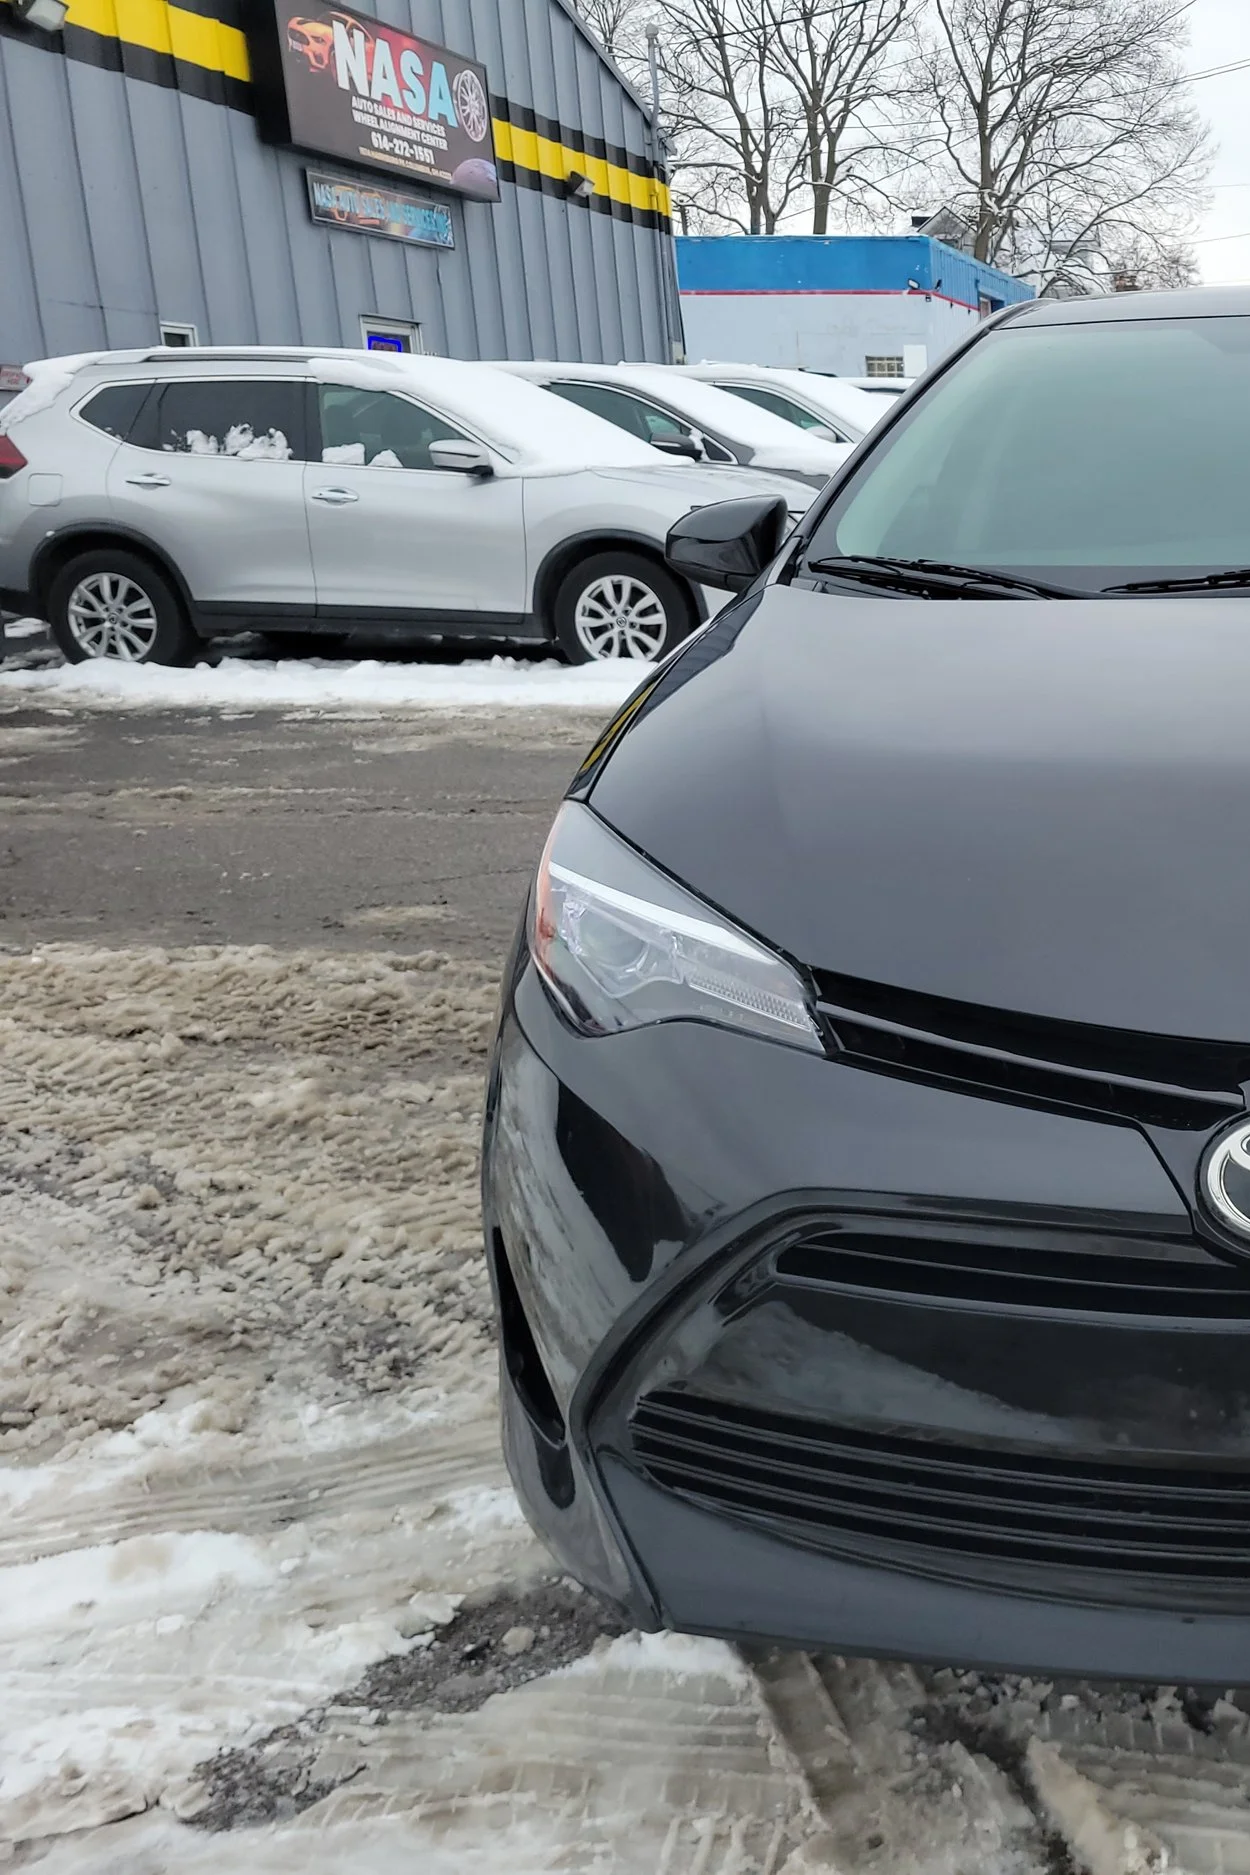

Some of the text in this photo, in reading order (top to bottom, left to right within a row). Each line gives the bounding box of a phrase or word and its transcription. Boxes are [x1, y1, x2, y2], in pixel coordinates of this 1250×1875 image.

[332, 20, 458, 128] NASA
[352, 95, 446, 137] AUTO SALES AND SERVICES
[352, 108, 448, 151] WHEEL ALIGNMENT CENTER
